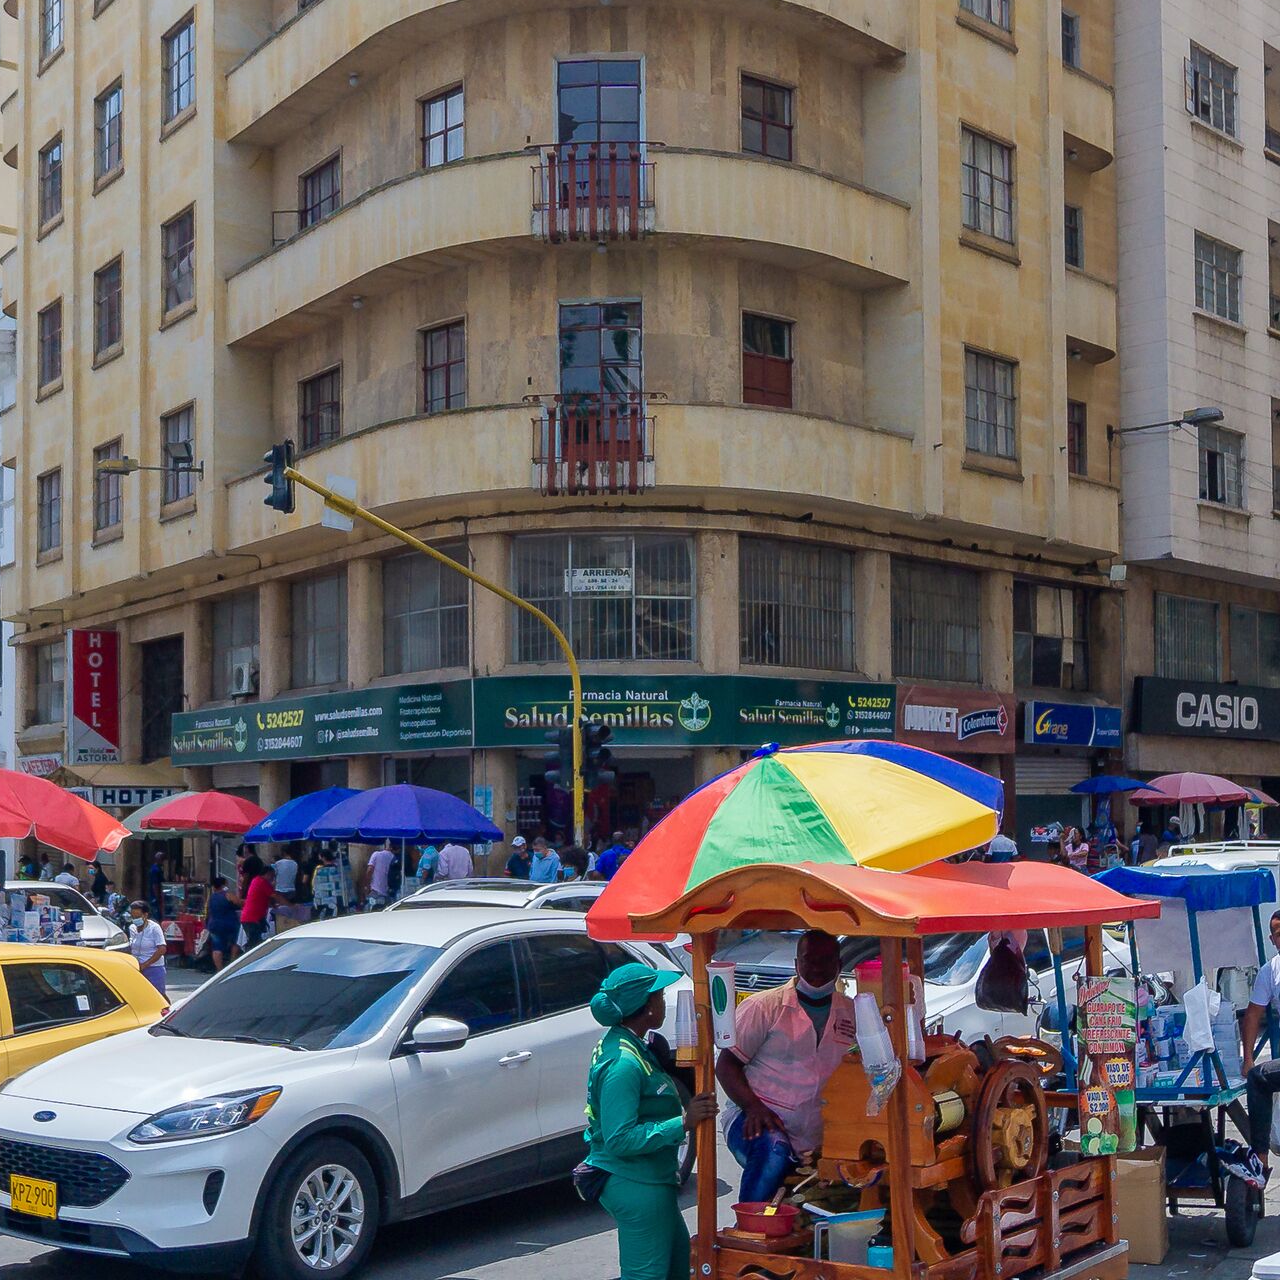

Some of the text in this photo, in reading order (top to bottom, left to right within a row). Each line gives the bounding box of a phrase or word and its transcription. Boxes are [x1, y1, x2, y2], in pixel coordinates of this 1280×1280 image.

[582, 569, 630, 577] ARRIENDA
[88, 633, 102, 727] HOTEL
[399, 693, 442, 704] Medicina Natural
[568, 689, 669, 701] Frmacia Natural
[775, 699, 823, 708] Farmacia Natural
[857, 696, 891, 709] 5242527
[315, 706, 383, 722] www.saludsemillas.com
[504, 705, 569, 729] Salud
[739, 708, 824, 725] Salud Semillas
[854, 711, 892, 720] 3152844607
[1176, 692, 1259, 730] CASIO
[195, 717, 231, 728] Farmacia Natural
[266, 710, 304, 729] 5242527
[904, 704, 958, 733] MARKET
[963, 713, 996, 733] Colombina
[336, 726, 379, 741] @saludsemillas
[441, 728, 472, 738] Deportiva
[173, 731, 233, 751] Salud Semillas
[76, 753, 118, 762] ASTORIA
[102, 788, 170, 805] HOTE
[1087, 1002, 1125, 1013] GUARAPO DE
[1087, 1028, 1131, 1039] REFRESCANTE
[1088, 1042, 1103, 1053] CON
[1105, 1063, 1130, 1073] VASO DE
[1109, 1073, 1130, 1083] $3.000
[1086, 1091, 1109, 1102] VASO DE
[12, 1181, 55, 1209] KPZ 900
